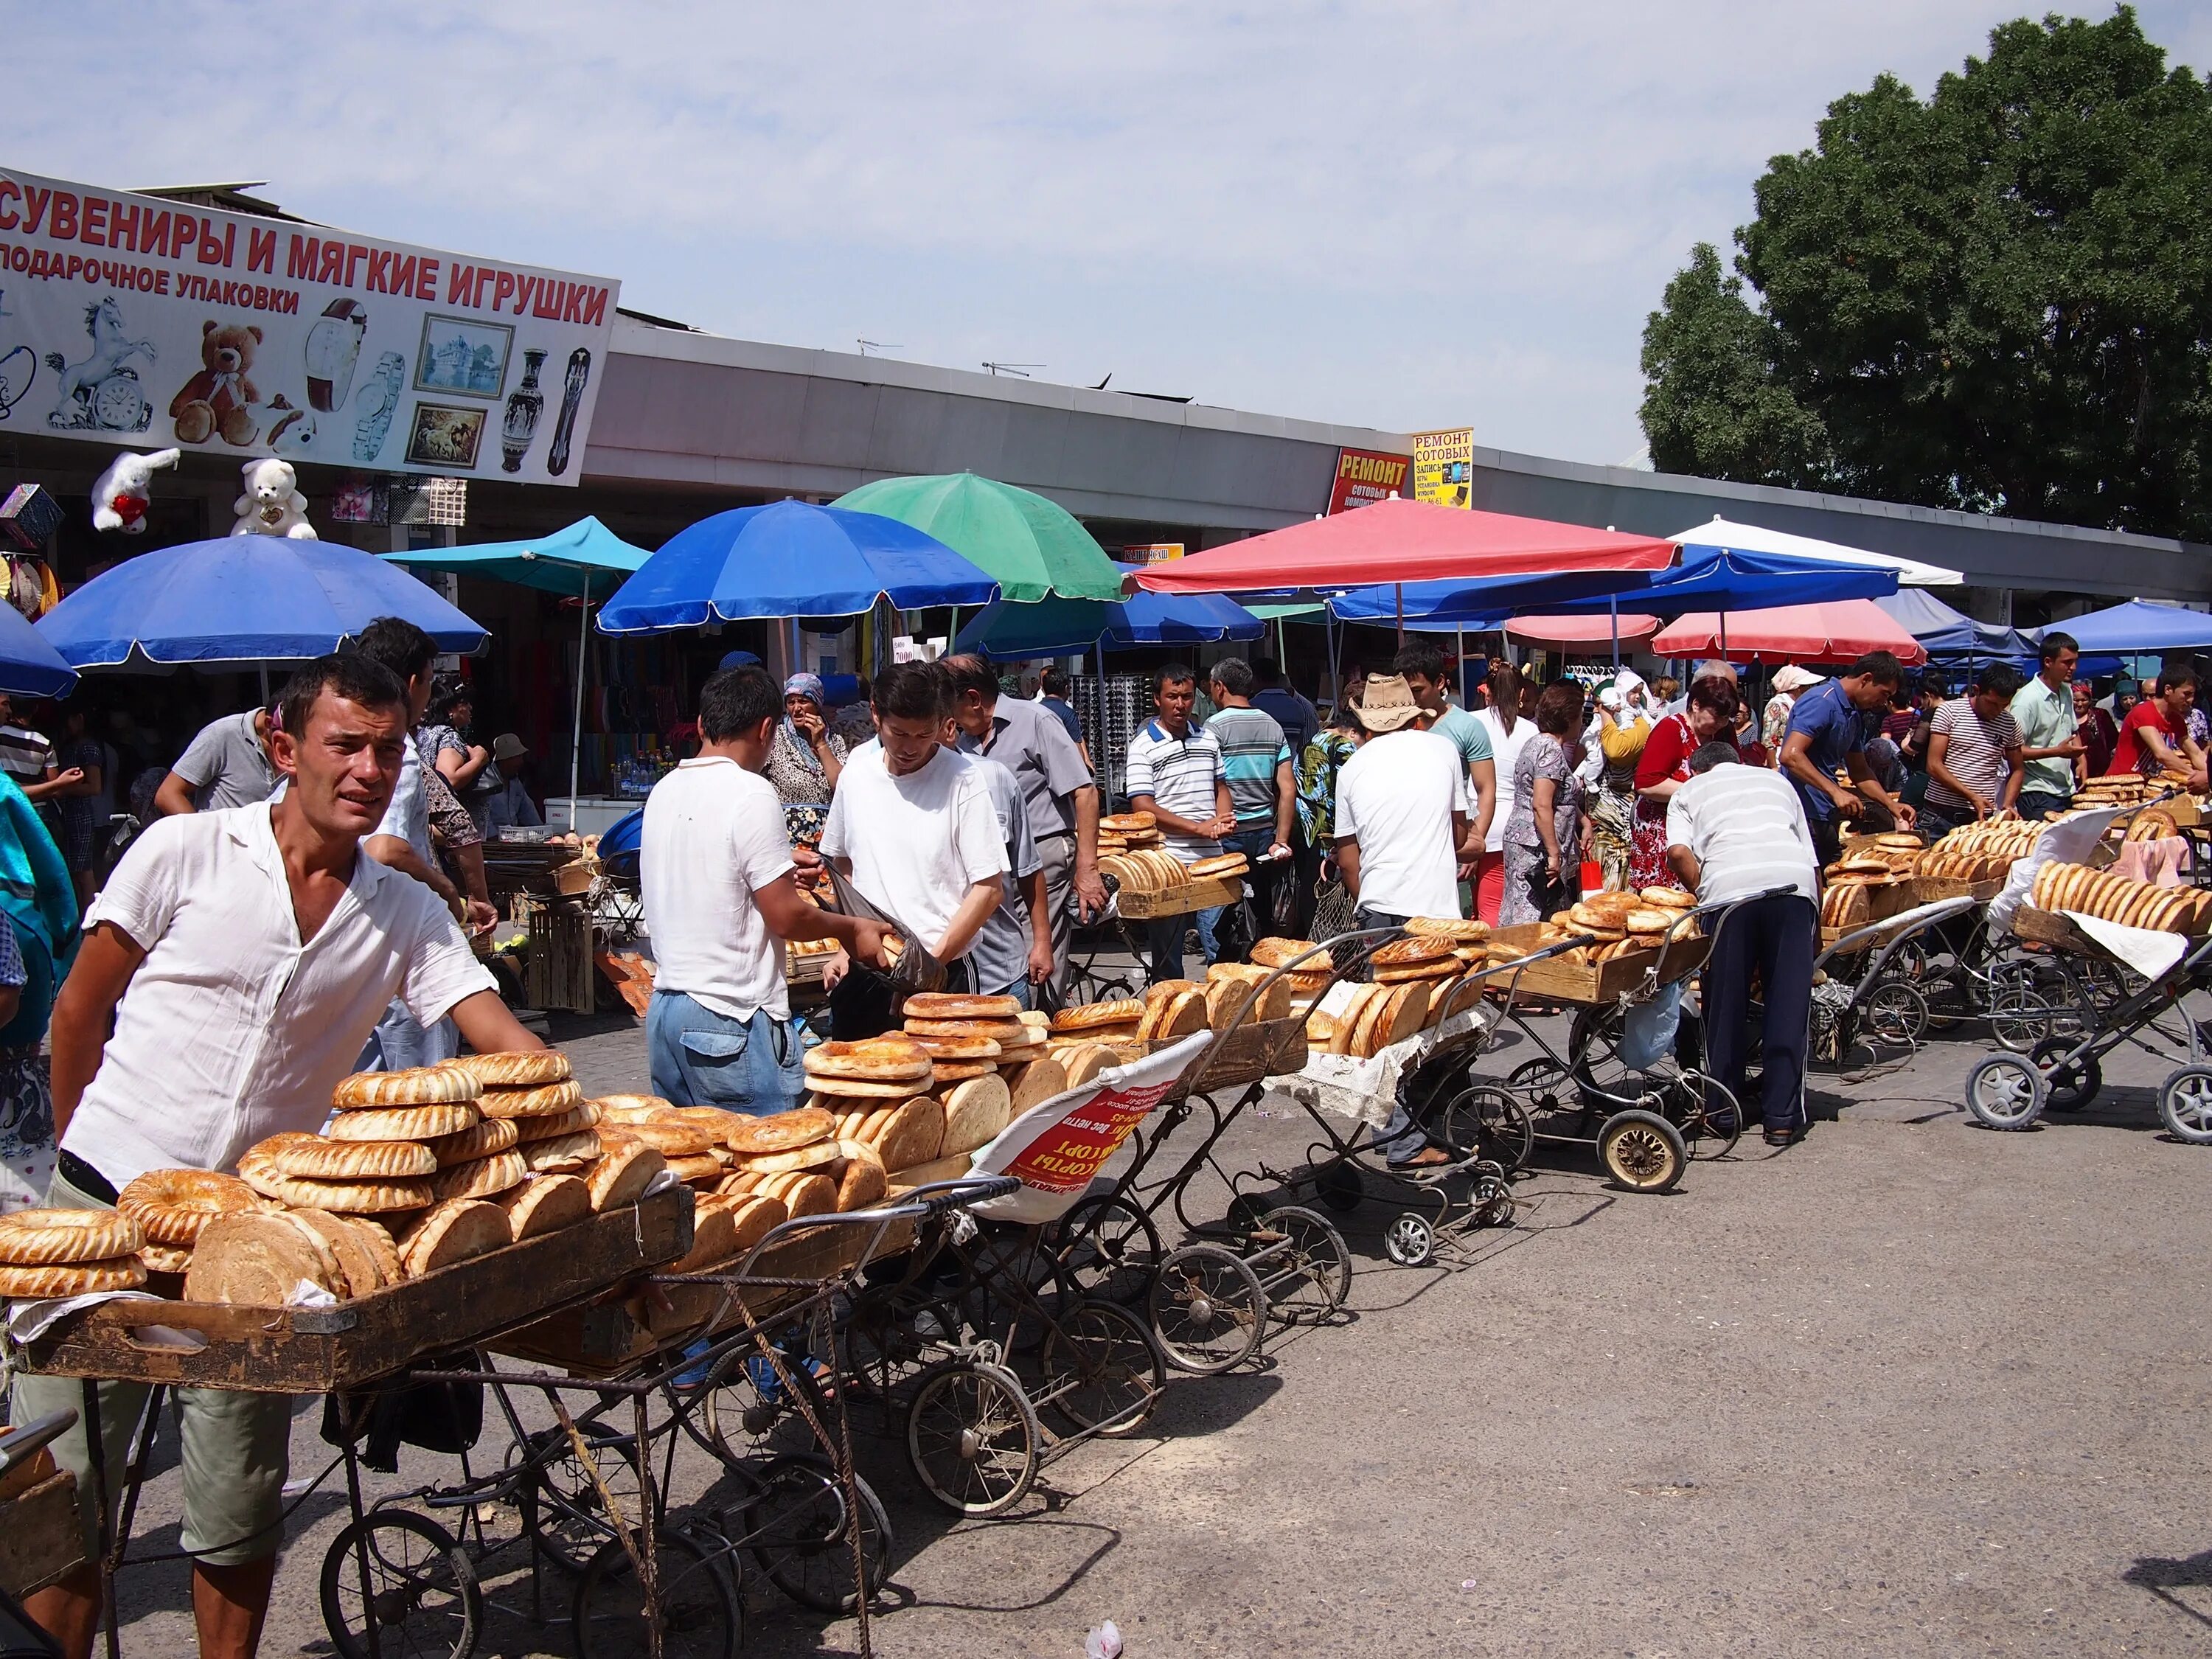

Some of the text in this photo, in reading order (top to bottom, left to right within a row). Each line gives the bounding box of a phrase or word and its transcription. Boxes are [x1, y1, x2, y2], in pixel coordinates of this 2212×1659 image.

[0, 181, 609, 326] СУВЕНИРЫ И МЯГКИЕ ИГРУШКИ
[0, 243, 299, 315] ПОДАРОЧНОЕ УПАКОВКИ
[1415, 432, 1470, 448] РЕМОНТ
[1416, 446, 1470, 462] СОТОВЫХ
[1340, 454, 1406, 485] РЕМОНТ
[1416, 463, 1441, 474] ЗАПИСЬ
[1352, 484, 1387, 499] СОТОВЫХ
[895, 651, 913, 663] 7000
[1062, 1116, 1091, 1130] нетто
[1091, 1122, 1110, 1135] Вес
[1053, 1141, 1102, 1160] СОРТ
[1031, 1153, 1095, 1175] СОРТЫ
